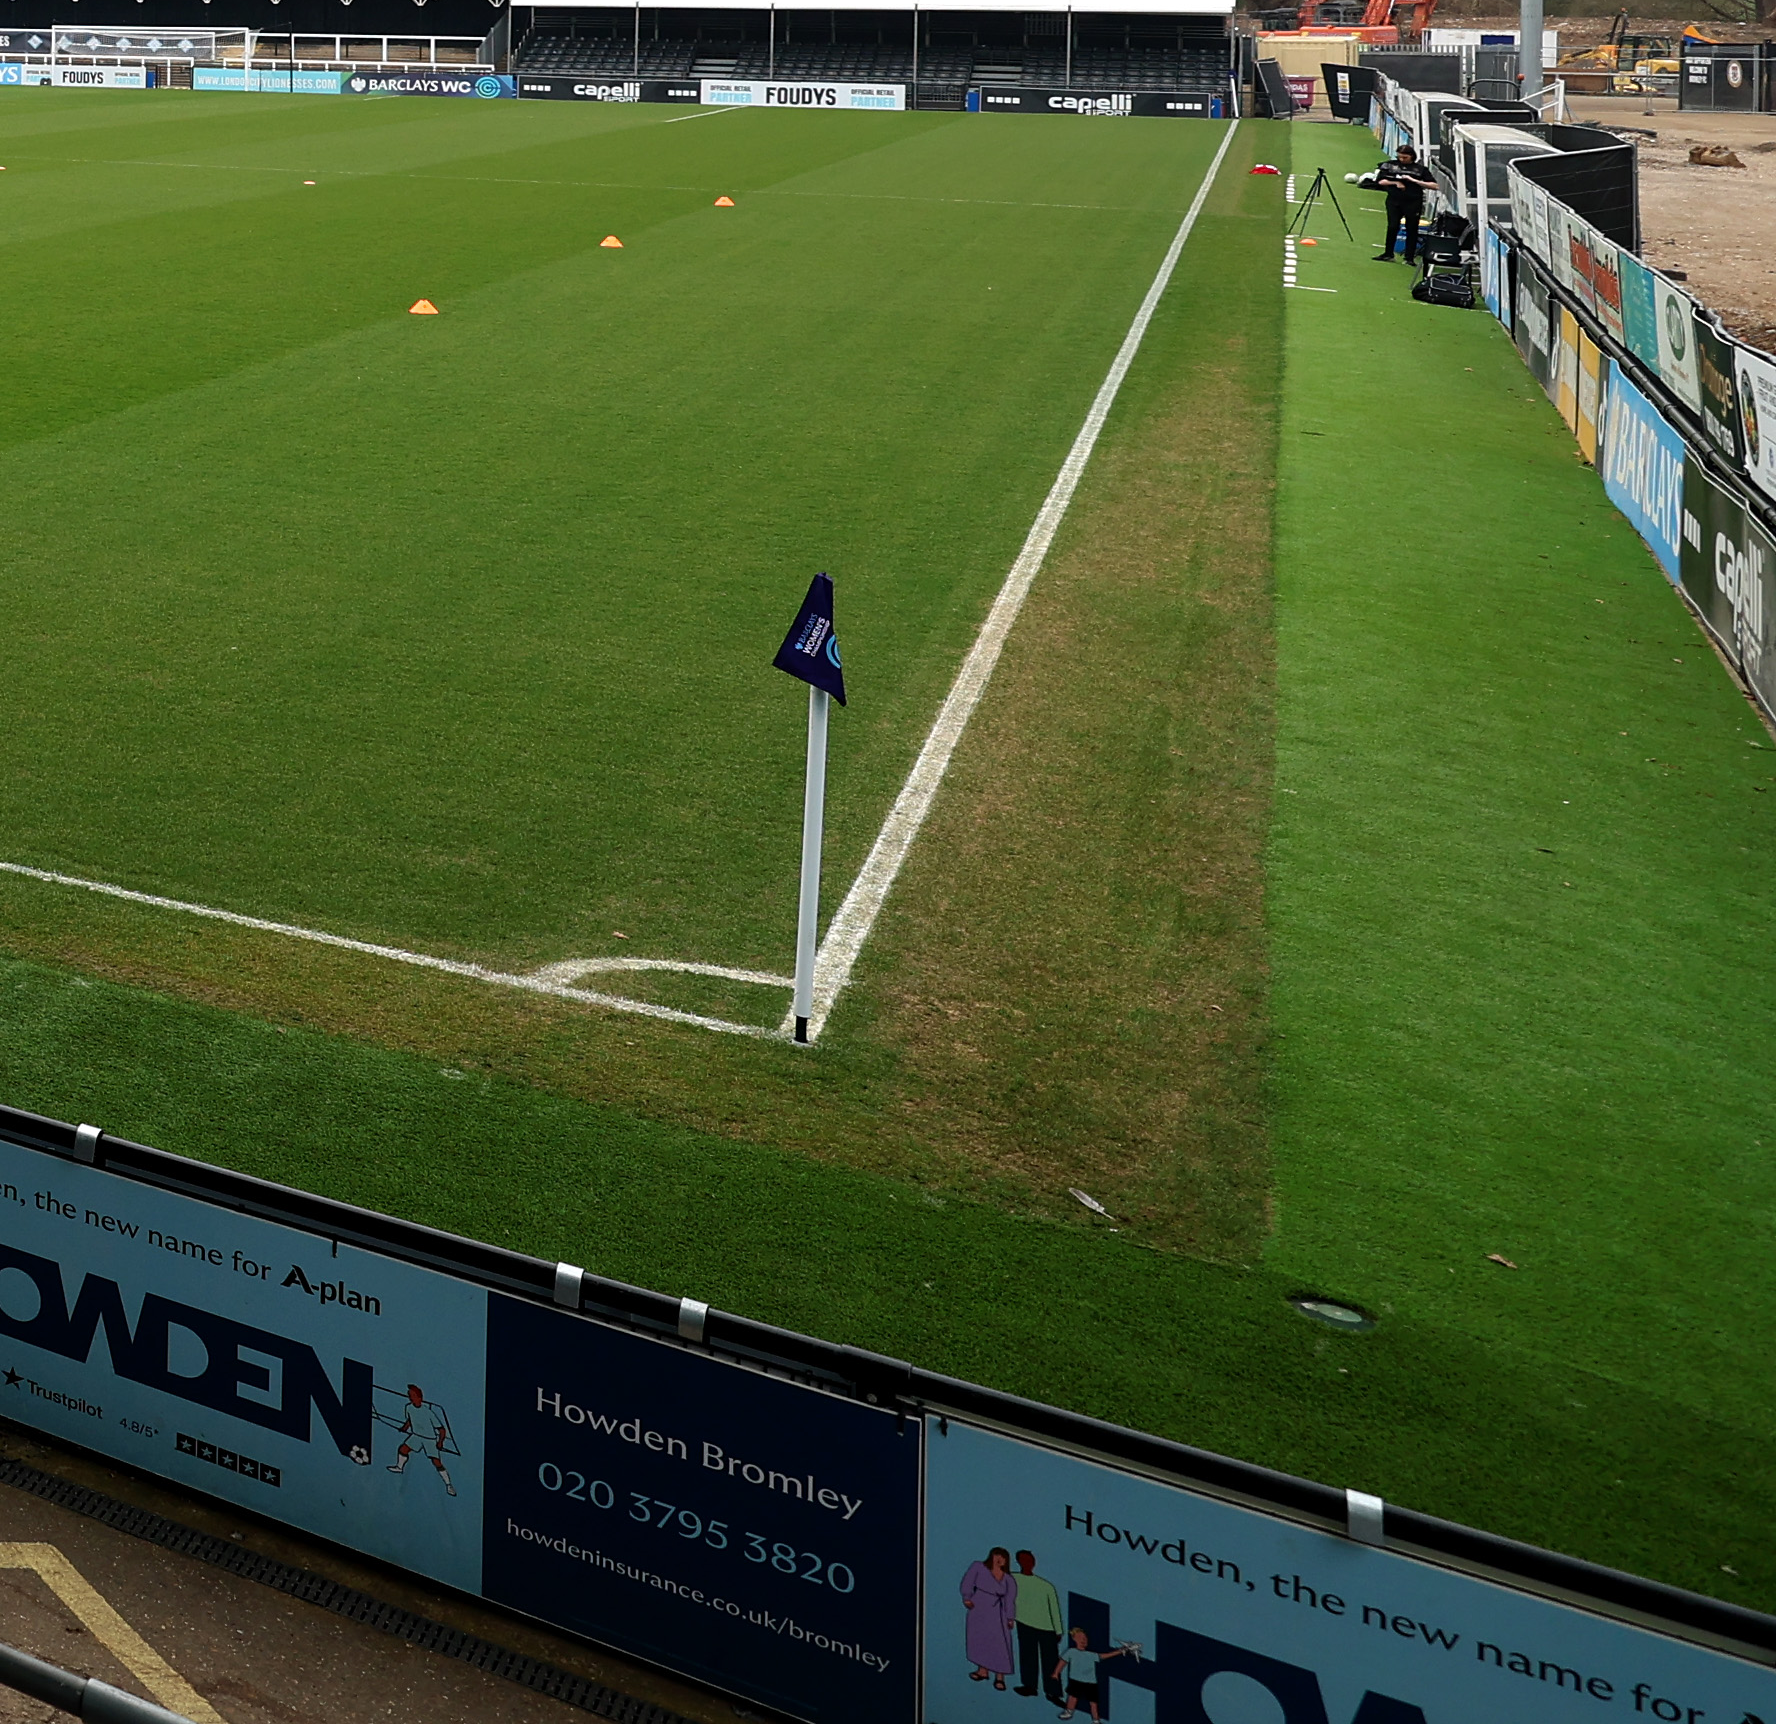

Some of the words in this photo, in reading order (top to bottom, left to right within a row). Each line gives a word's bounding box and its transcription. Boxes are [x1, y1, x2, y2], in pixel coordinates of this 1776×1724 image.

[62, 71, 104, 85] FOUDYS
[367, 78, 439, 94] BARCLAYS
[441, 80, 472, 95] WC
[573, 81, 642, 102] capelli
[709, 92, 753, 104] PARTNER
[765, 86, 837, 106] FOUDYS
[850, 96, 895, 108] PARTNER
[1048, 93, 1134, 113] capelli
[802, 617, 826, 655] WOMEN'S
[33, 1188, 78, 1220] the
[83, 1207, 140, 1242] new
[146, 1227, 224, 1268] name
[230, 1246, 273, 1282] for
[279, 1262, 383, 1318] A-plan
[26, 1377, 104, 1421] Trustpilot
[535, 1386, 690, 1461] Howden
[700, 1440, 864, 1522] Bromley
[537, 1460, 615, 1511] 020
[627, 1491, 729, 1551] 3795
[743, 1531, 856, 1595] 3820
[506, 1518, 891, 1674] howdeninsurance.co.uk/bromley
[1063, 1503, 1256, 1594] Howden,
[1271, 1573, 1346, 1617] the
[1361, 1601, 1460, 1653] new
[1477, 1639, 1616, 1702] name
[1631, 1682, 1706, 1724] for
